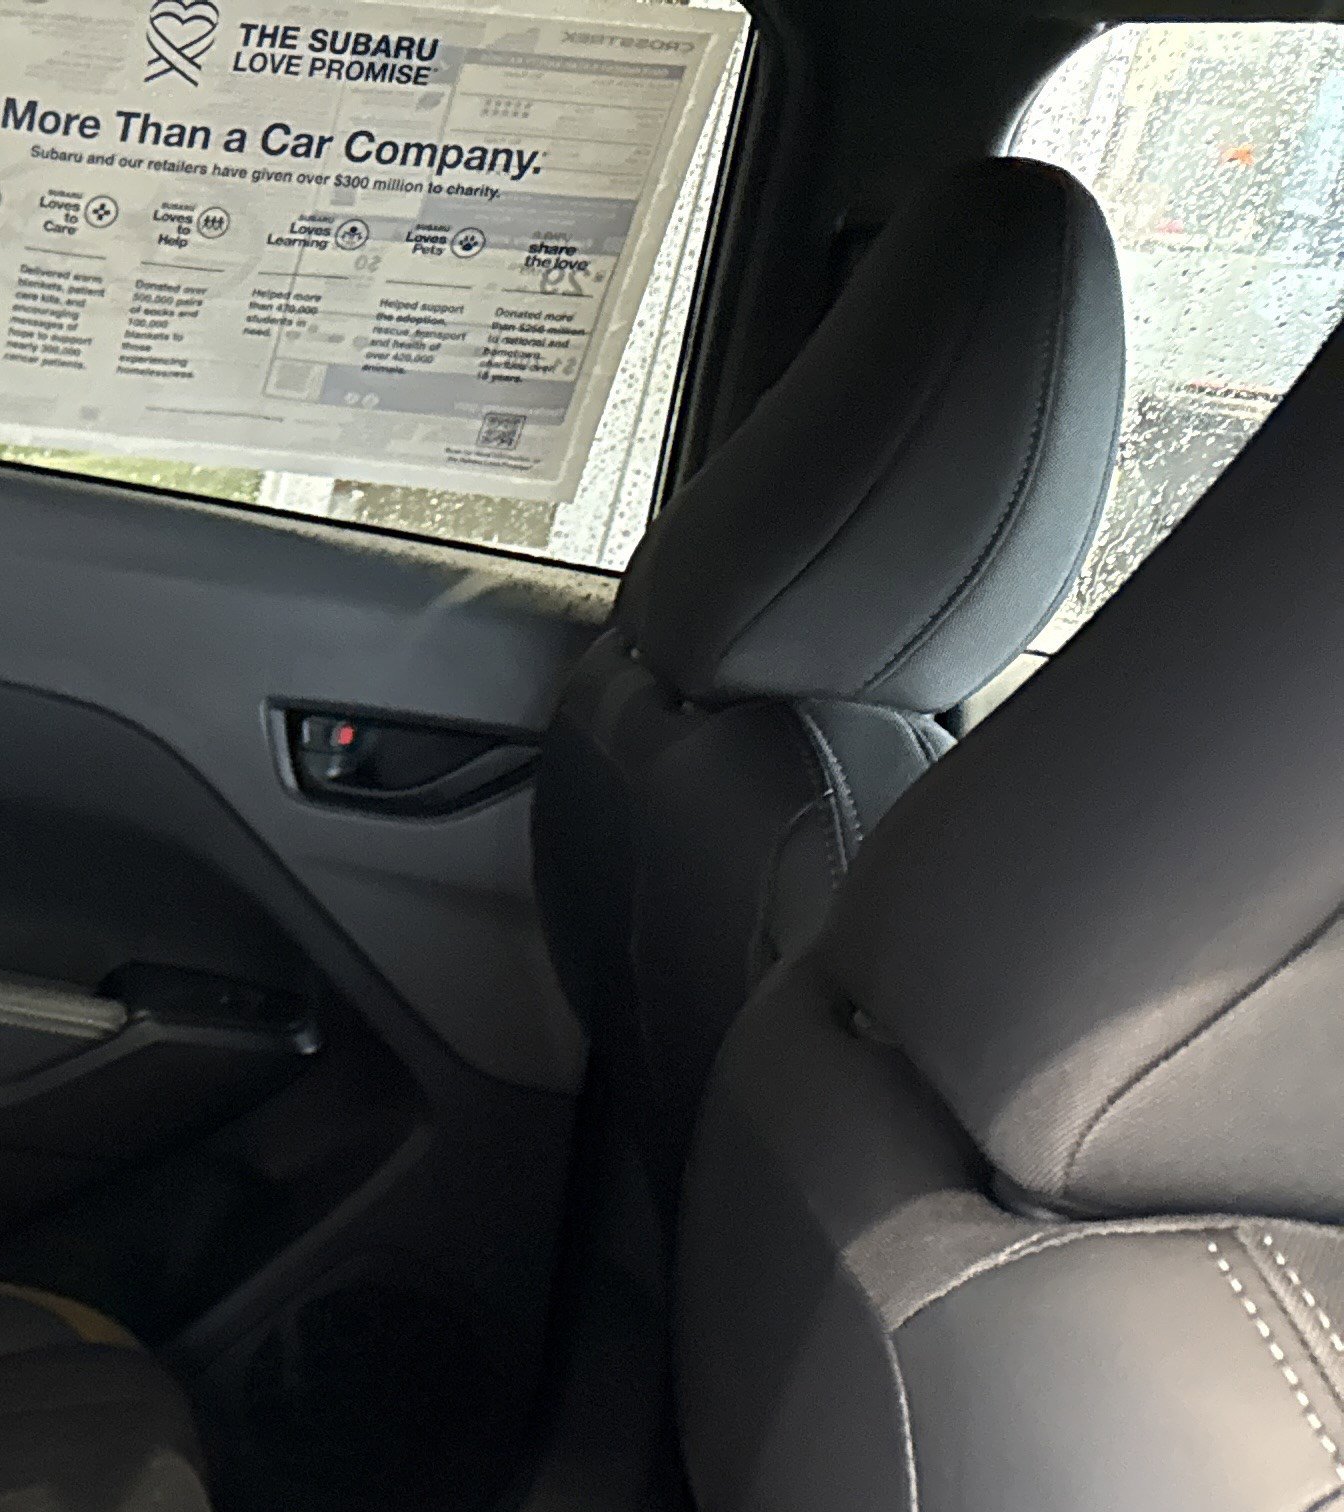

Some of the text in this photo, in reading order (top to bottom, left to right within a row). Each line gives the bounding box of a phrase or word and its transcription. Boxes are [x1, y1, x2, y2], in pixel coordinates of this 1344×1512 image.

[239, 22, 440, 62] THE SUBARU
[232, 51, 431, 87] LOVE PROMISE
[0, 97, 542, 181] More Than a Car Company.
[30, 145, 501, 200] Subaru and our retailers have given over $300 million to charity.
[39, 197, 81, 212] Loves
[64, 212, 79, 224] to
[153, 209, 193, 225] Loves
[43, 220, 77, 235] Care
[177, 224, 191, 236] to
[289, 222, 332, 236] Loves
[157, 233, 189, 249] Help
[266, 233, 329, 251] Learning
[406, 231, 448, 245] Loves
[412, 244, 445, 256] Pets
[528, 241, 577, 257] share
[524, 255, 589, 271] the love
